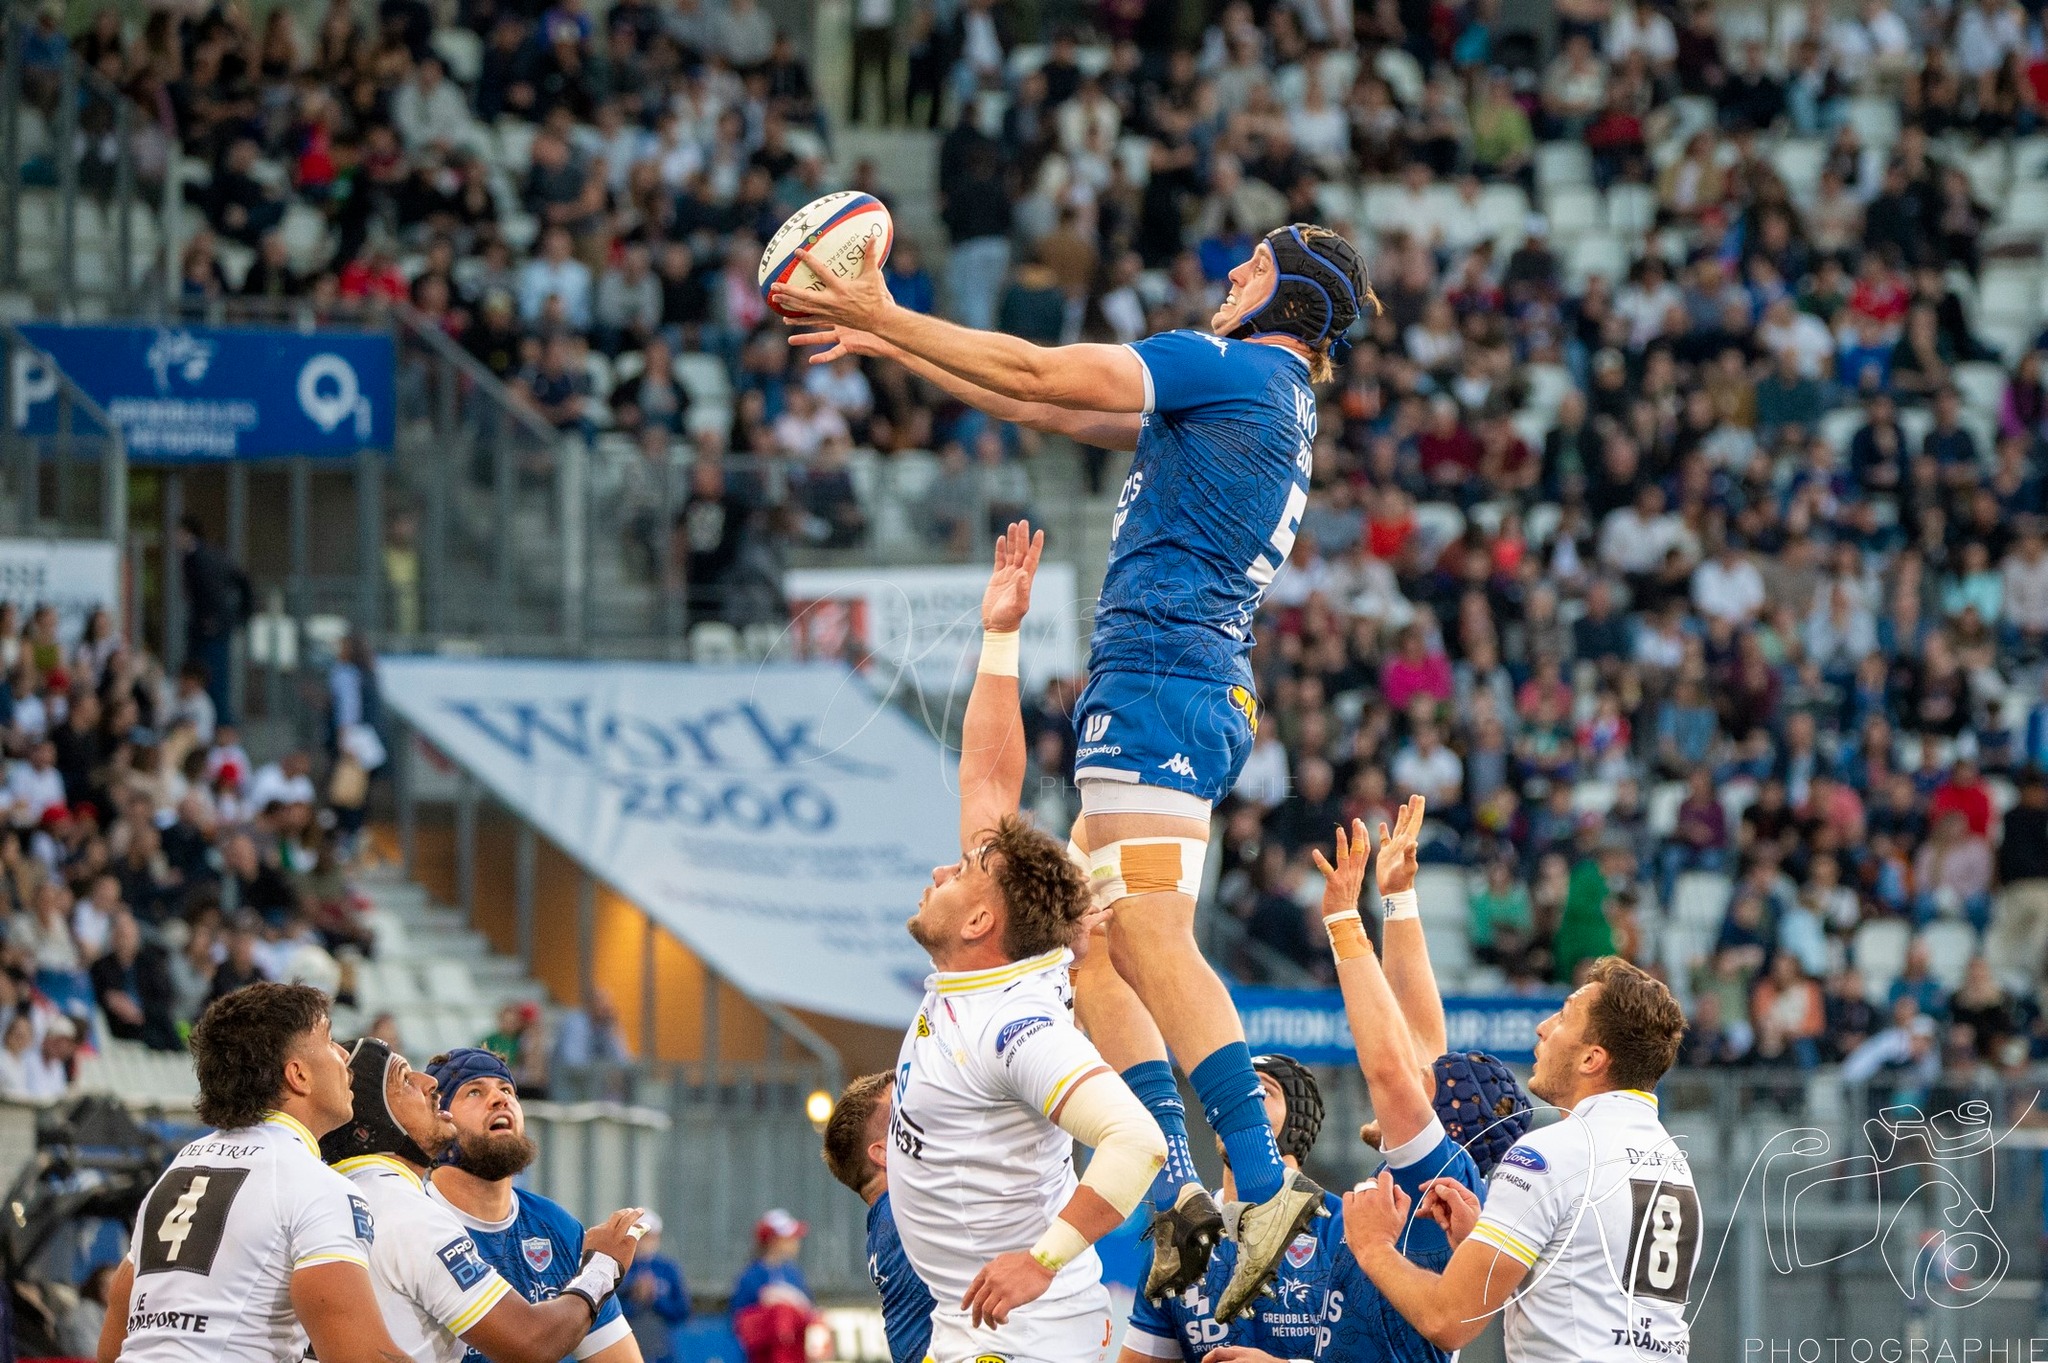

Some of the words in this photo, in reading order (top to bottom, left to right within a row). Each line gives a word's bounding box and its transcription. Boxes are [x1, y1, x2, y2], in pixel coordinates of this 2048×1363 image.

[1246, 481, 1308, 590] 5
[448, 697, 890, 777] Work
[607, 775, 836, 833] 2000
[1504, 1148, 1537, 1167] Ford
[157, 1175, 210, 1262] 4
[1648, 1194, 1681, 1290] 8
[127, 1311, 209, 1333] ANSPORTE
[1185, 1317, 1229, 1345] SD
[1271, 1324, 1321, 1337] MÉTROPO
